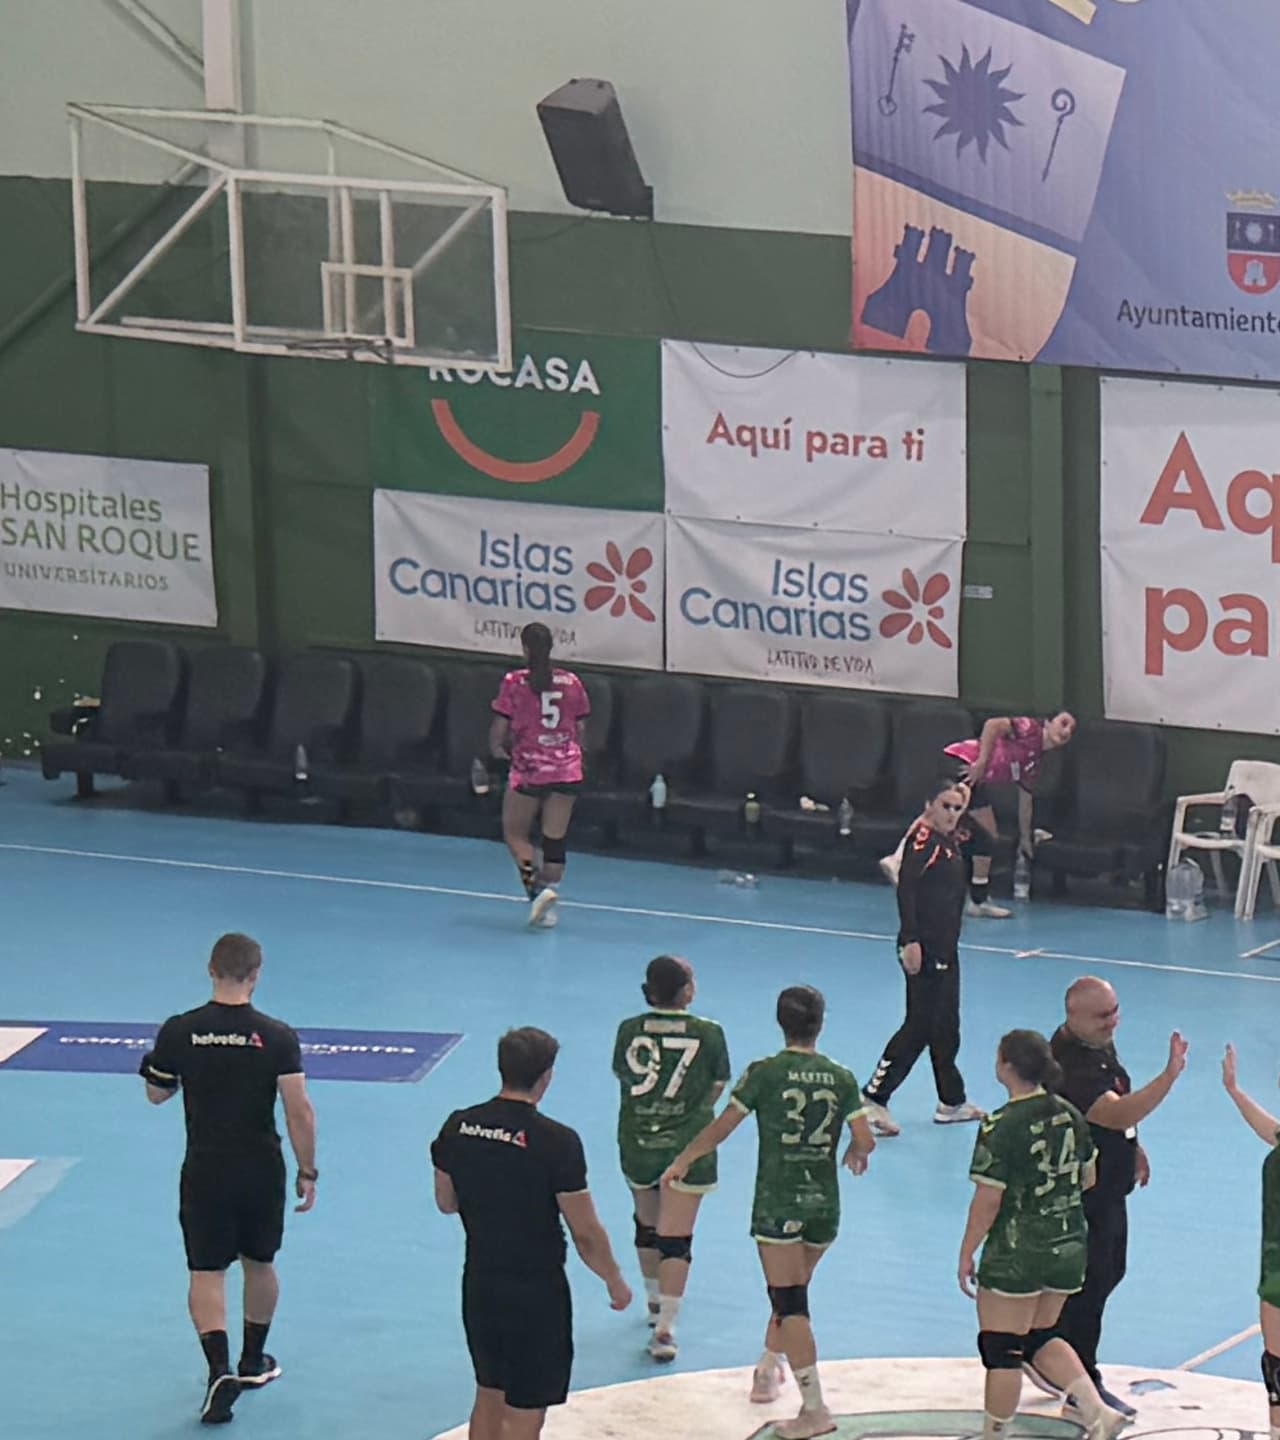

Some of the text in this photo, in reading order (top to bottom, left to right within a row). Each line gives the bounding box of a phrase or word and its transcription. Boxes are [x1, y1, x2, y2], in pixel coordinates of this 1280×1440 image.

[706, 412, 925, 462] Aquí para ti
[0, 481, 163, 522] Hospitales
[1, 517, 201, 562] SAN ROQUE
[480, 529, 573, 576] Islas
[3, 562, 169, 591] UNIVERSITARIOS
[389, 557, 577, 614] Canarias
[771, 559, 869, 603] Islas
[680, 587, 872, 642] Canarias
[768, 649, 819, 670] LATITUD
[824, 655, 841, 673] DE
[541, 691, 563, 729] 5
[191, 1032, 247, 1046] helvetia
[625, 1036, 701, 1099] 97
[459, 1121, 513, 1142] helvetia
[781, 1088, 839, 1144] 32
[1030, 1127, 1081, 1197] 34
